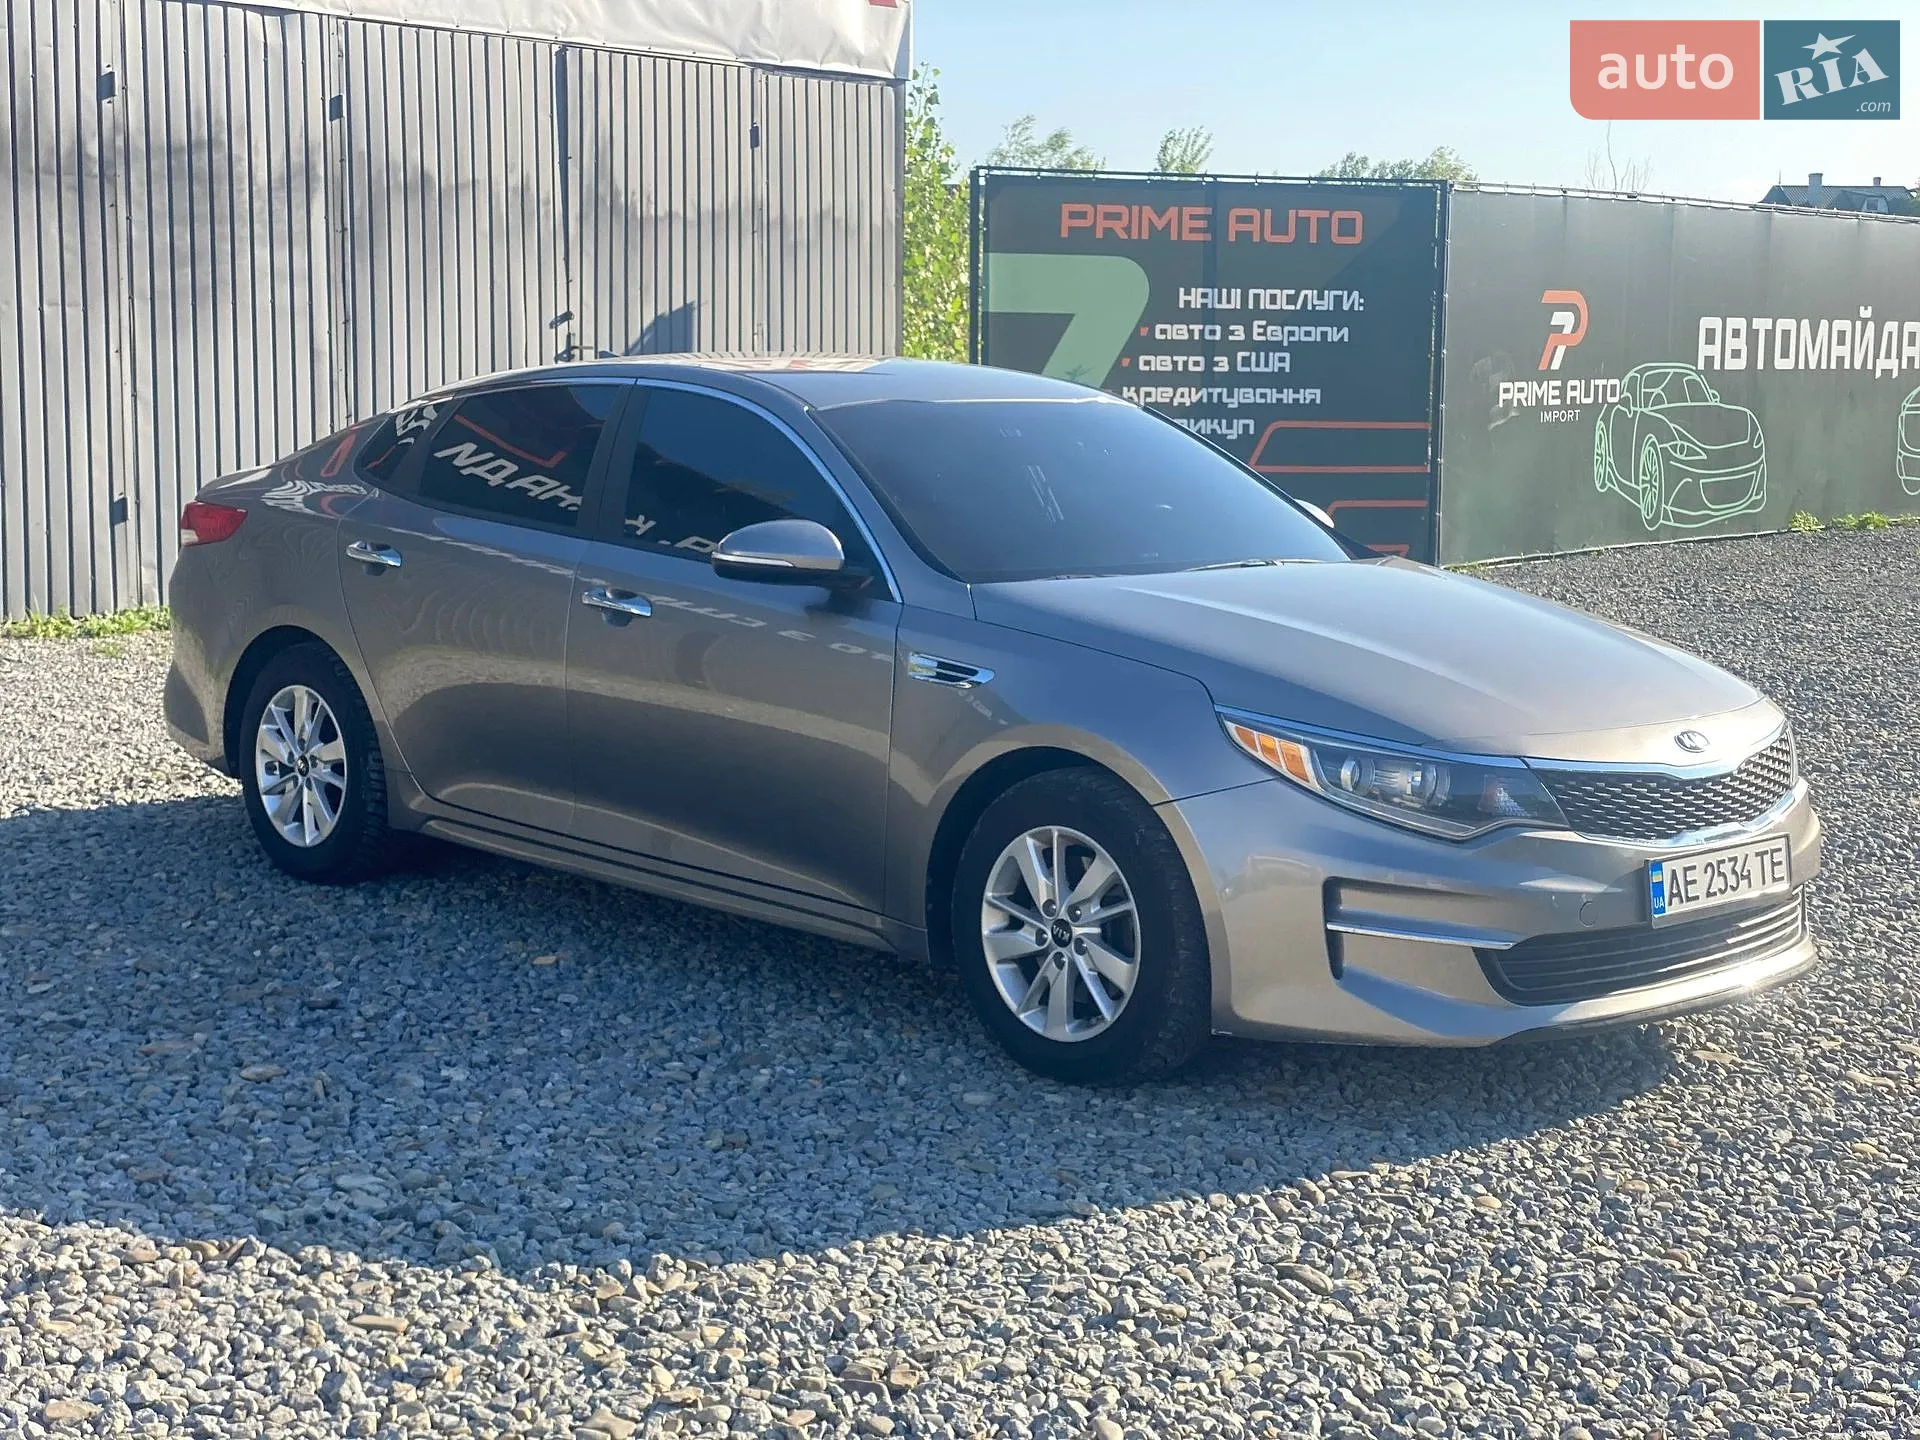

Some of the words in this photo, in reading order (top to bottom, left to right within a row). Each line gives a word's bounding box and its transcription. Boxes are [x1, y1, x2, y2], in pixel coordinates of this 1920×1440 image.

[1060, 204, 1212, 241] PRIME
[1228, 208, 1364, 244] AUTO
[1178, 287, 1242, 309] НАШІ
[1248, 289, 1364, 311] ПОСЛУГИ:
[1154, 323, 1221, 340] авто
[1138, 355, 1205, 372] авто
[1236, 351, 1290, 373] США
[1122, 386, 1321, 408] кредитування
[1499, 380, 1562, 408] PRIME
[1566, 378, 1620, 405] AUTO
[1540, 409, 1580, 423] IMPORT
[1668, 865, 1699, 906] AE
[1703, 853, 1751, 897] 2534
[1755, 847, 1785, 885] TE
[1653, 896, 1665, 909] UA
